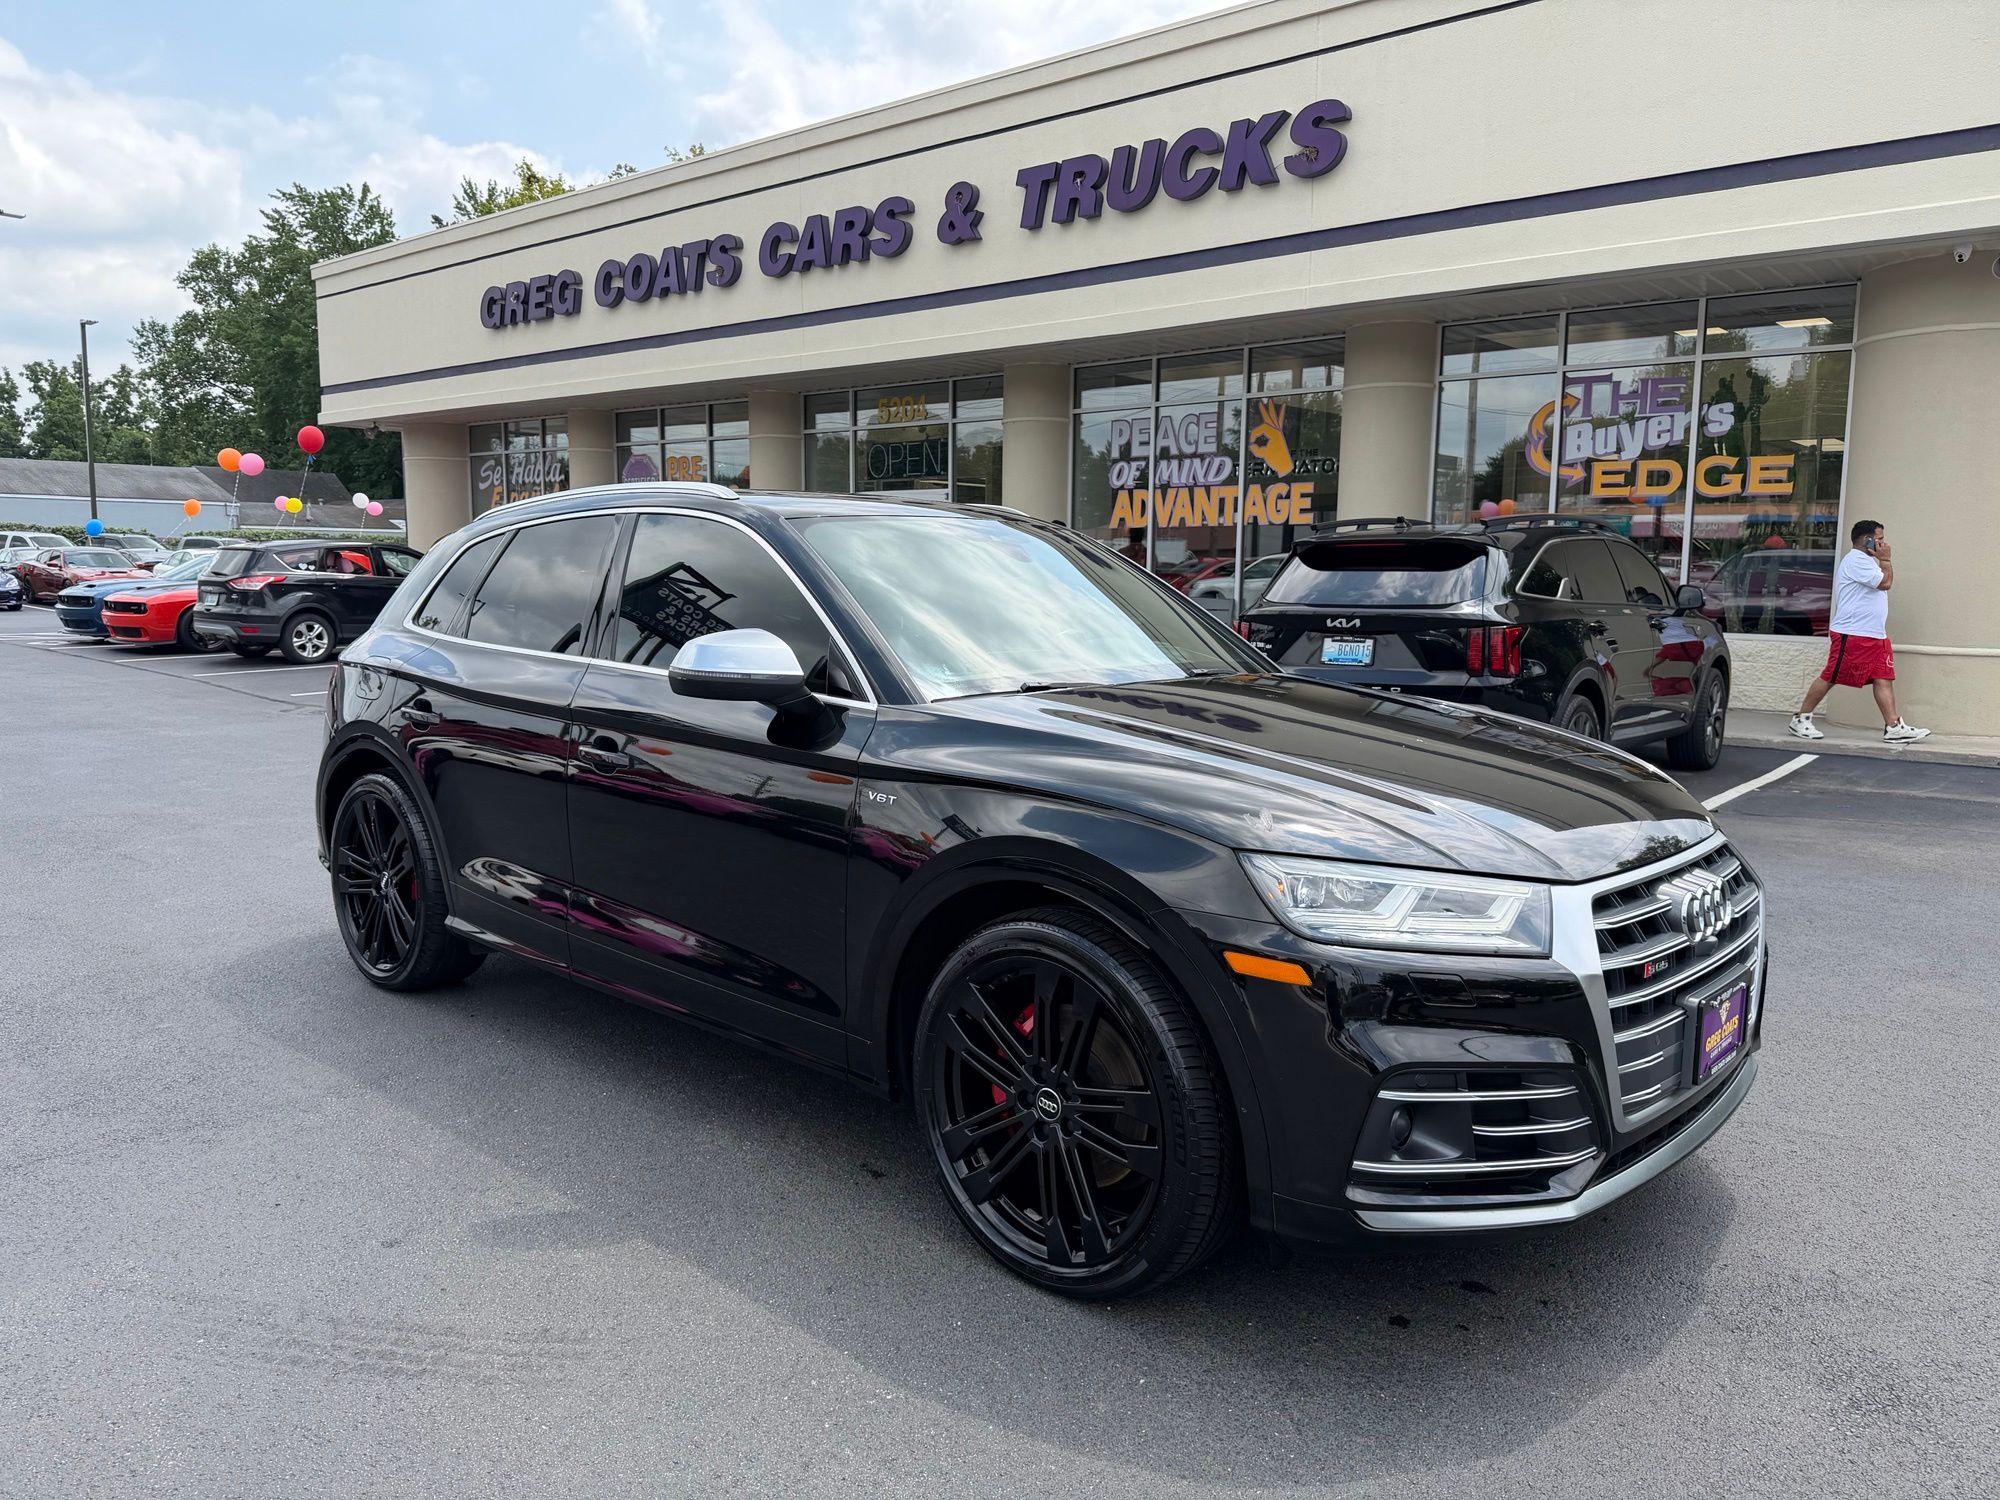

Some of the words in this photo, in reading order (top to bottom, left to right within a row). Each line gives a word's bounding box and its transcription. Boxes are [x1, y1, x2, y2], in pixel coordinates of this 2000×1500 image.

[480, 269, 582, 329] GREG
[595, 233, 743, 308] COATS
[759, 196, 915, 277] CARS
[937, 180, 984, 245] &
[1016, 98, 1352, 230] TRUCKS
[878, 393, 928, 423] 5204
[1565, 373, 1688, 419] THE
[1110, 411, 1218, 458] PEACE
[1563, 401, 1735, 465] Buyer's
[478, 459, 502, 490] Se
[511, 455, 565, 484] Habla
[868, 440, 941, 478] OPEN
[1109, 460, 1147, 489] OF
[1154, 454, 1234, 488] MIND
[1590, 454, 1795, 498] EDGE
[1109, 482, 1315, 529] ADVANTAGE
[868, 791, 897, 805] V6T
